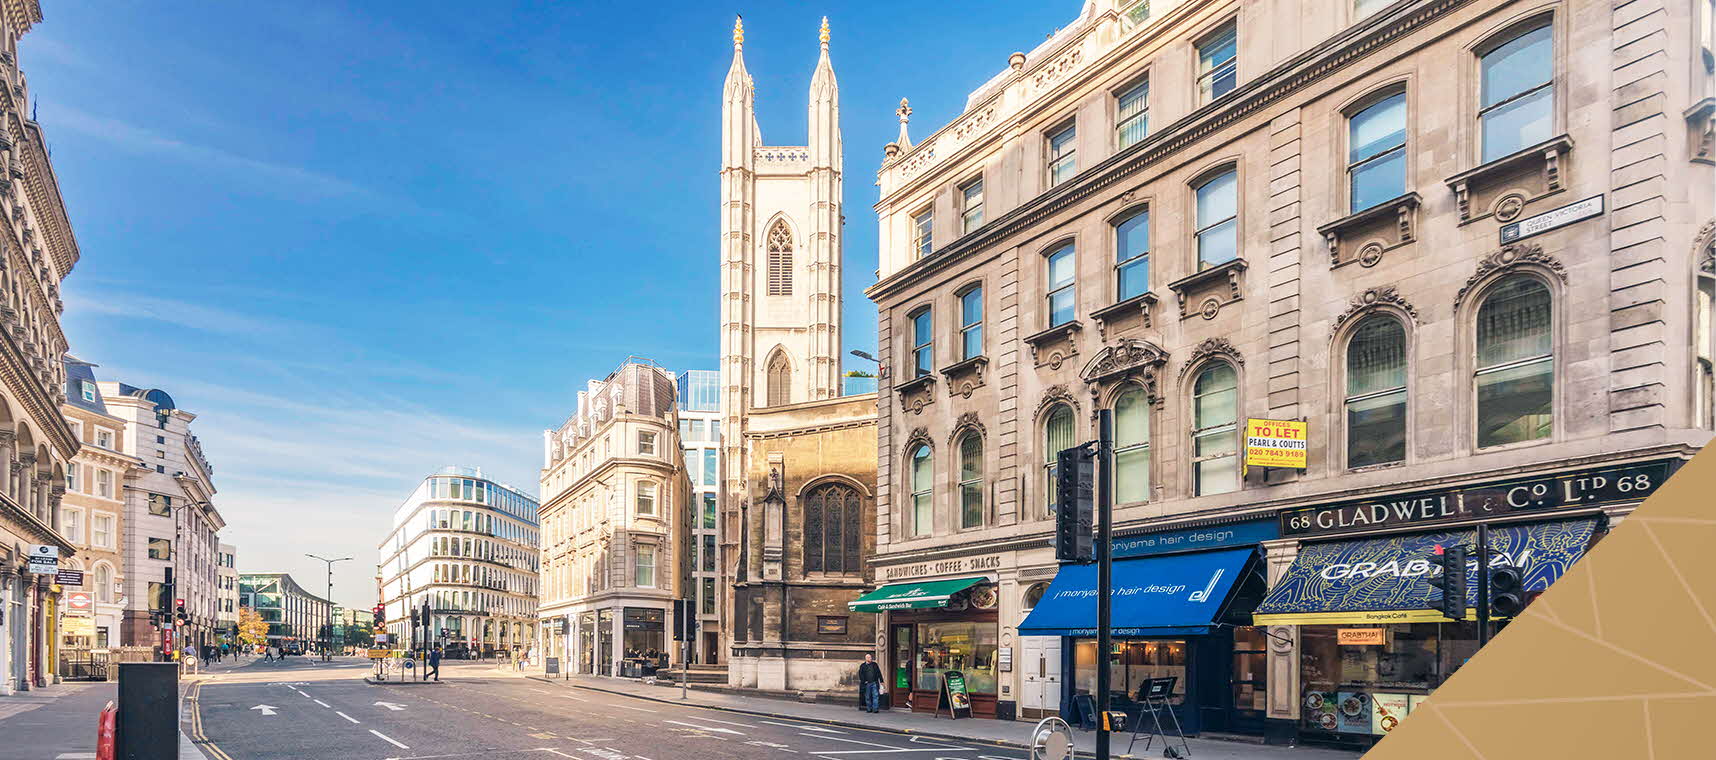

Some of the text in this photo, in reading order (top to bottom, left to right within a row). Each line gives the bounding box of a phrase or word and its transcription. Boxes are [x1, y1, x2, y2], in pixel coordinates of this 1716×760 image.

[1526, 215, 1552, 227] QUEEN
[1555, 201, 1592, 218] VICTORIA
[1526, 220, 1552, 233] STREET
[1254, 427, 1300, 438] TO LET
[1249, 438, 1270, 447] PEARL
[1279, 440, 1305, 448] COUTTS
[1290, 516, 1310, 530] 68
[1316, 494, 1472, 529] GLADWELL
[1617, 474, 1651, 492] 68
[1111, 530, 1234, 551] oriyama hair design
[886, 556, 1000, 578] SANDWICHES COFFEE SNACKS
[1117, 586, 1143, 596] hair
[1144, 583, 1186, 595] design
[1118, 628, 1140, 636] design
